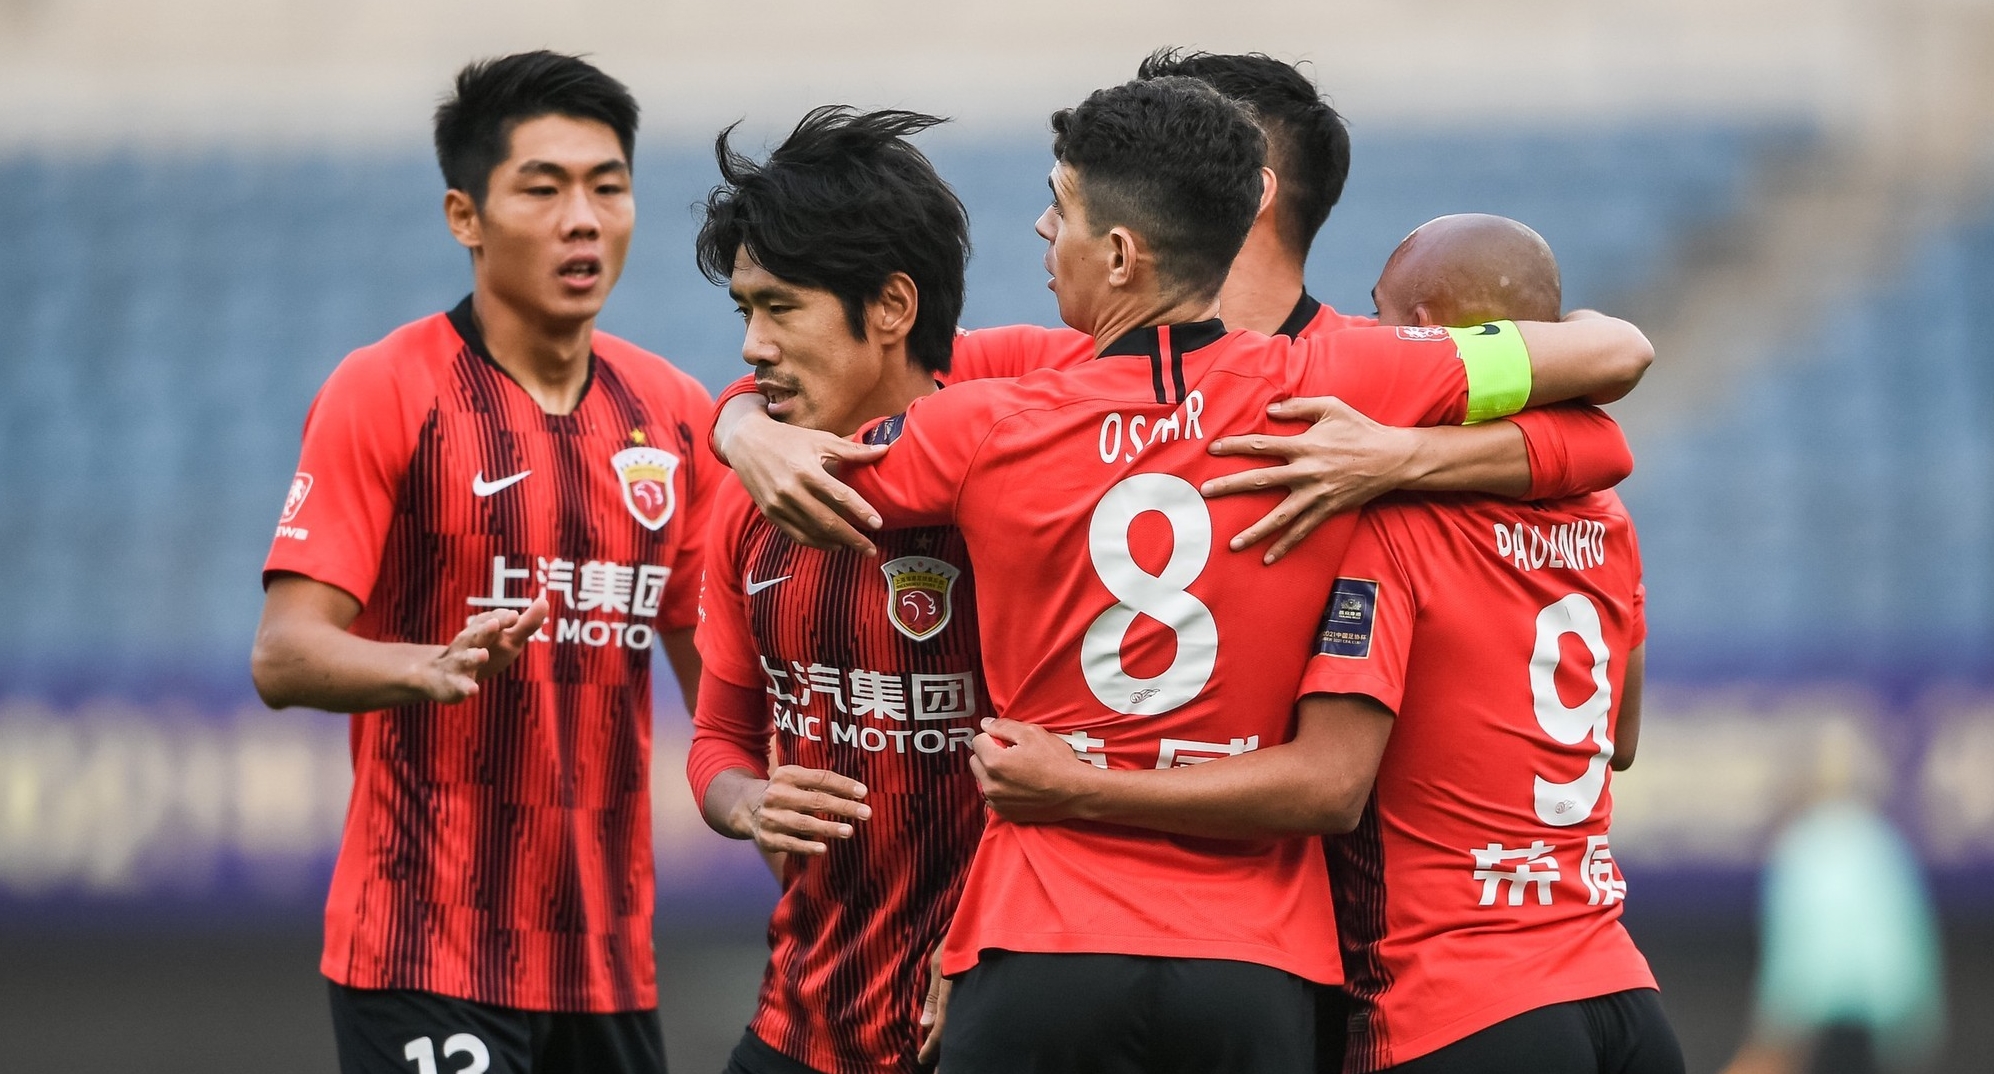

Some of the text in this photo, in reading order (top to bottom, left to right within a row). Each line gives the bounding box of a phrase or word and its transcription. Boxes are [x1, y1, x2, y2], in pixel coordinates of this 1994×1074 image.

[1098, 388, 1204, 464] OSCAR
[466, 555, 672, 617] 上汽集团
[1080, 472, 1219, 716] 8
[556, 617, 655, 650] MOTO
[760, 654, 977, 721] 上汽集团
[1528, 592, 1615, 826] 9
[773, 702, 977, 754] SAIC MOTOR
